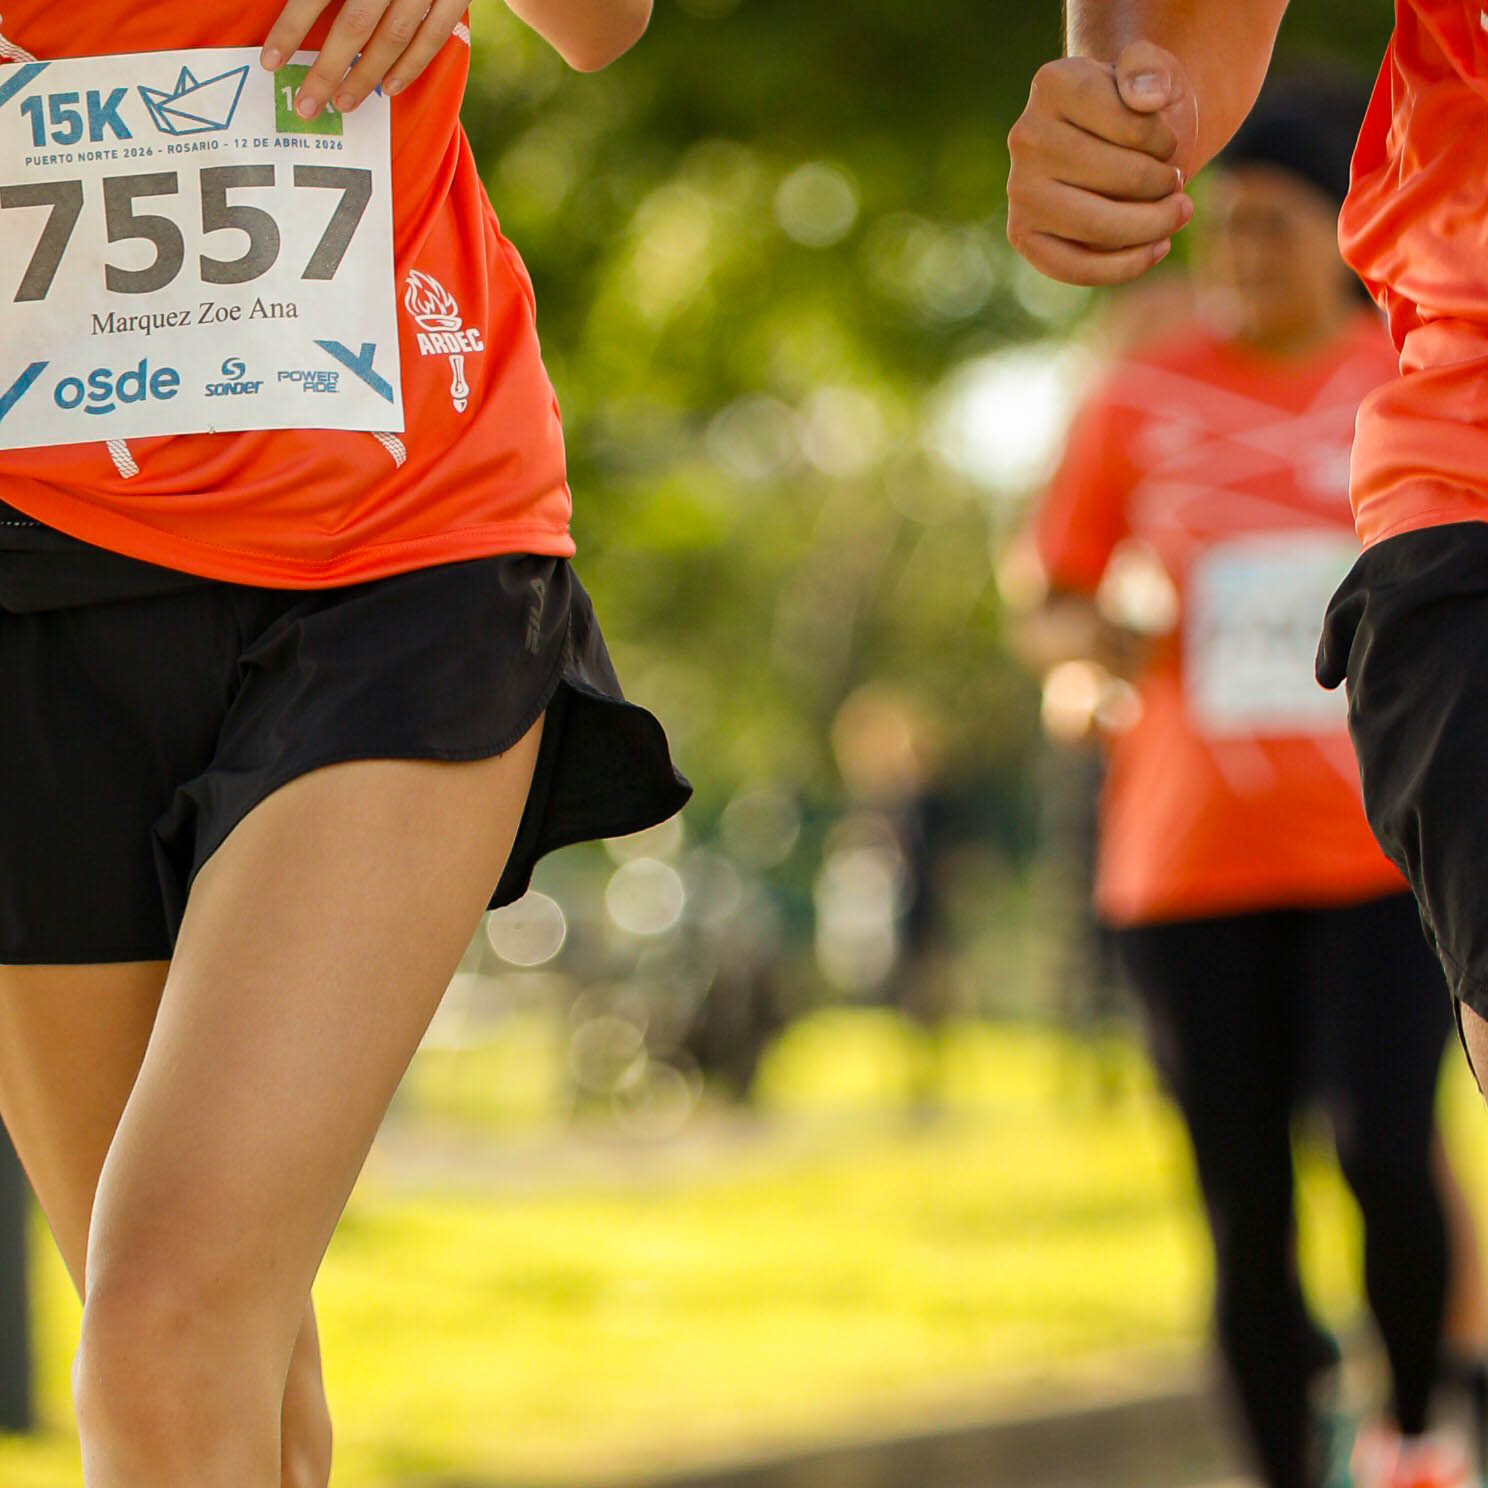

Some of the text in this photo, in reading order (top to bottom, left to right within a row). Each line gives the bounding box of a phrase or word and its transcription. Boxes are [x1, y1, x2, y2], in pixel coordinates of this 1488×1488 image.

[20, 88, 133, 148] 15K
[25, 153, 74, 167] PUERTO
[78, 149, 119, 162] NORTE
[123, 146, 154, 159] 2026
[167, 140, 219, 155] ROSARIO
[234, 138, 249, 149] 12
[253, 138, 269, 148] DE
[274, 138, 311, 149] ABRIL
[315, 139, 344, 151] 2026
[0, 164, 373, 303] 7557
[91, 297, 299, 337] Marquez Zoe Ana
[416, 327, 484, 356] ARDEC
[54, 358, 180, 416] osde
[277, 370, 340, 383] POWER
